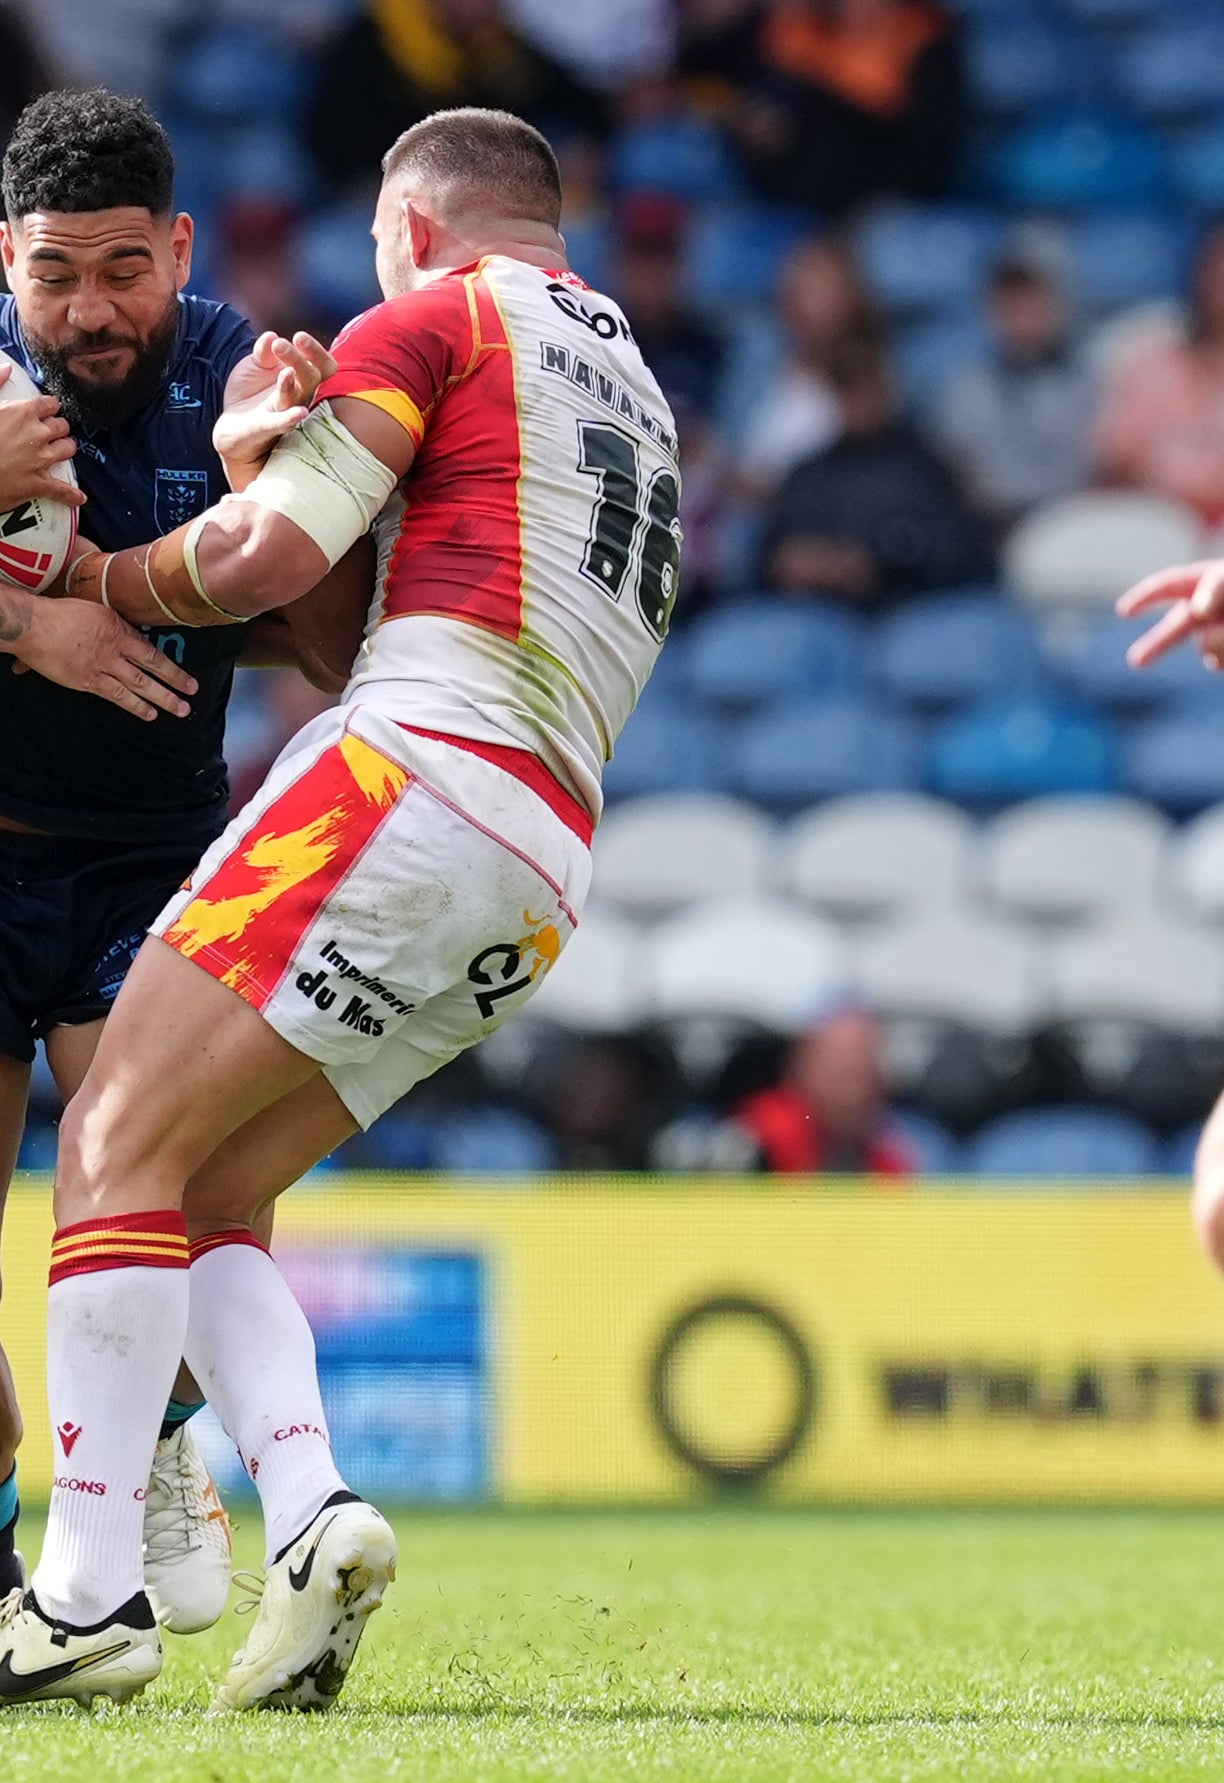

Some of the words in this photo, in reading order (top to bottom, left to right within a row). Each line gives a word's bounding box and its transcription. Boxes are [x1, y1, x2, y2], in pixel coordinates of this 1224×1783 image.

[540, 341, 678, 458] NAVARR
[576, 419, 682, 645] 16
[295, 970, 337, 1011] du
[337, 995, 385, 1037] Mas
